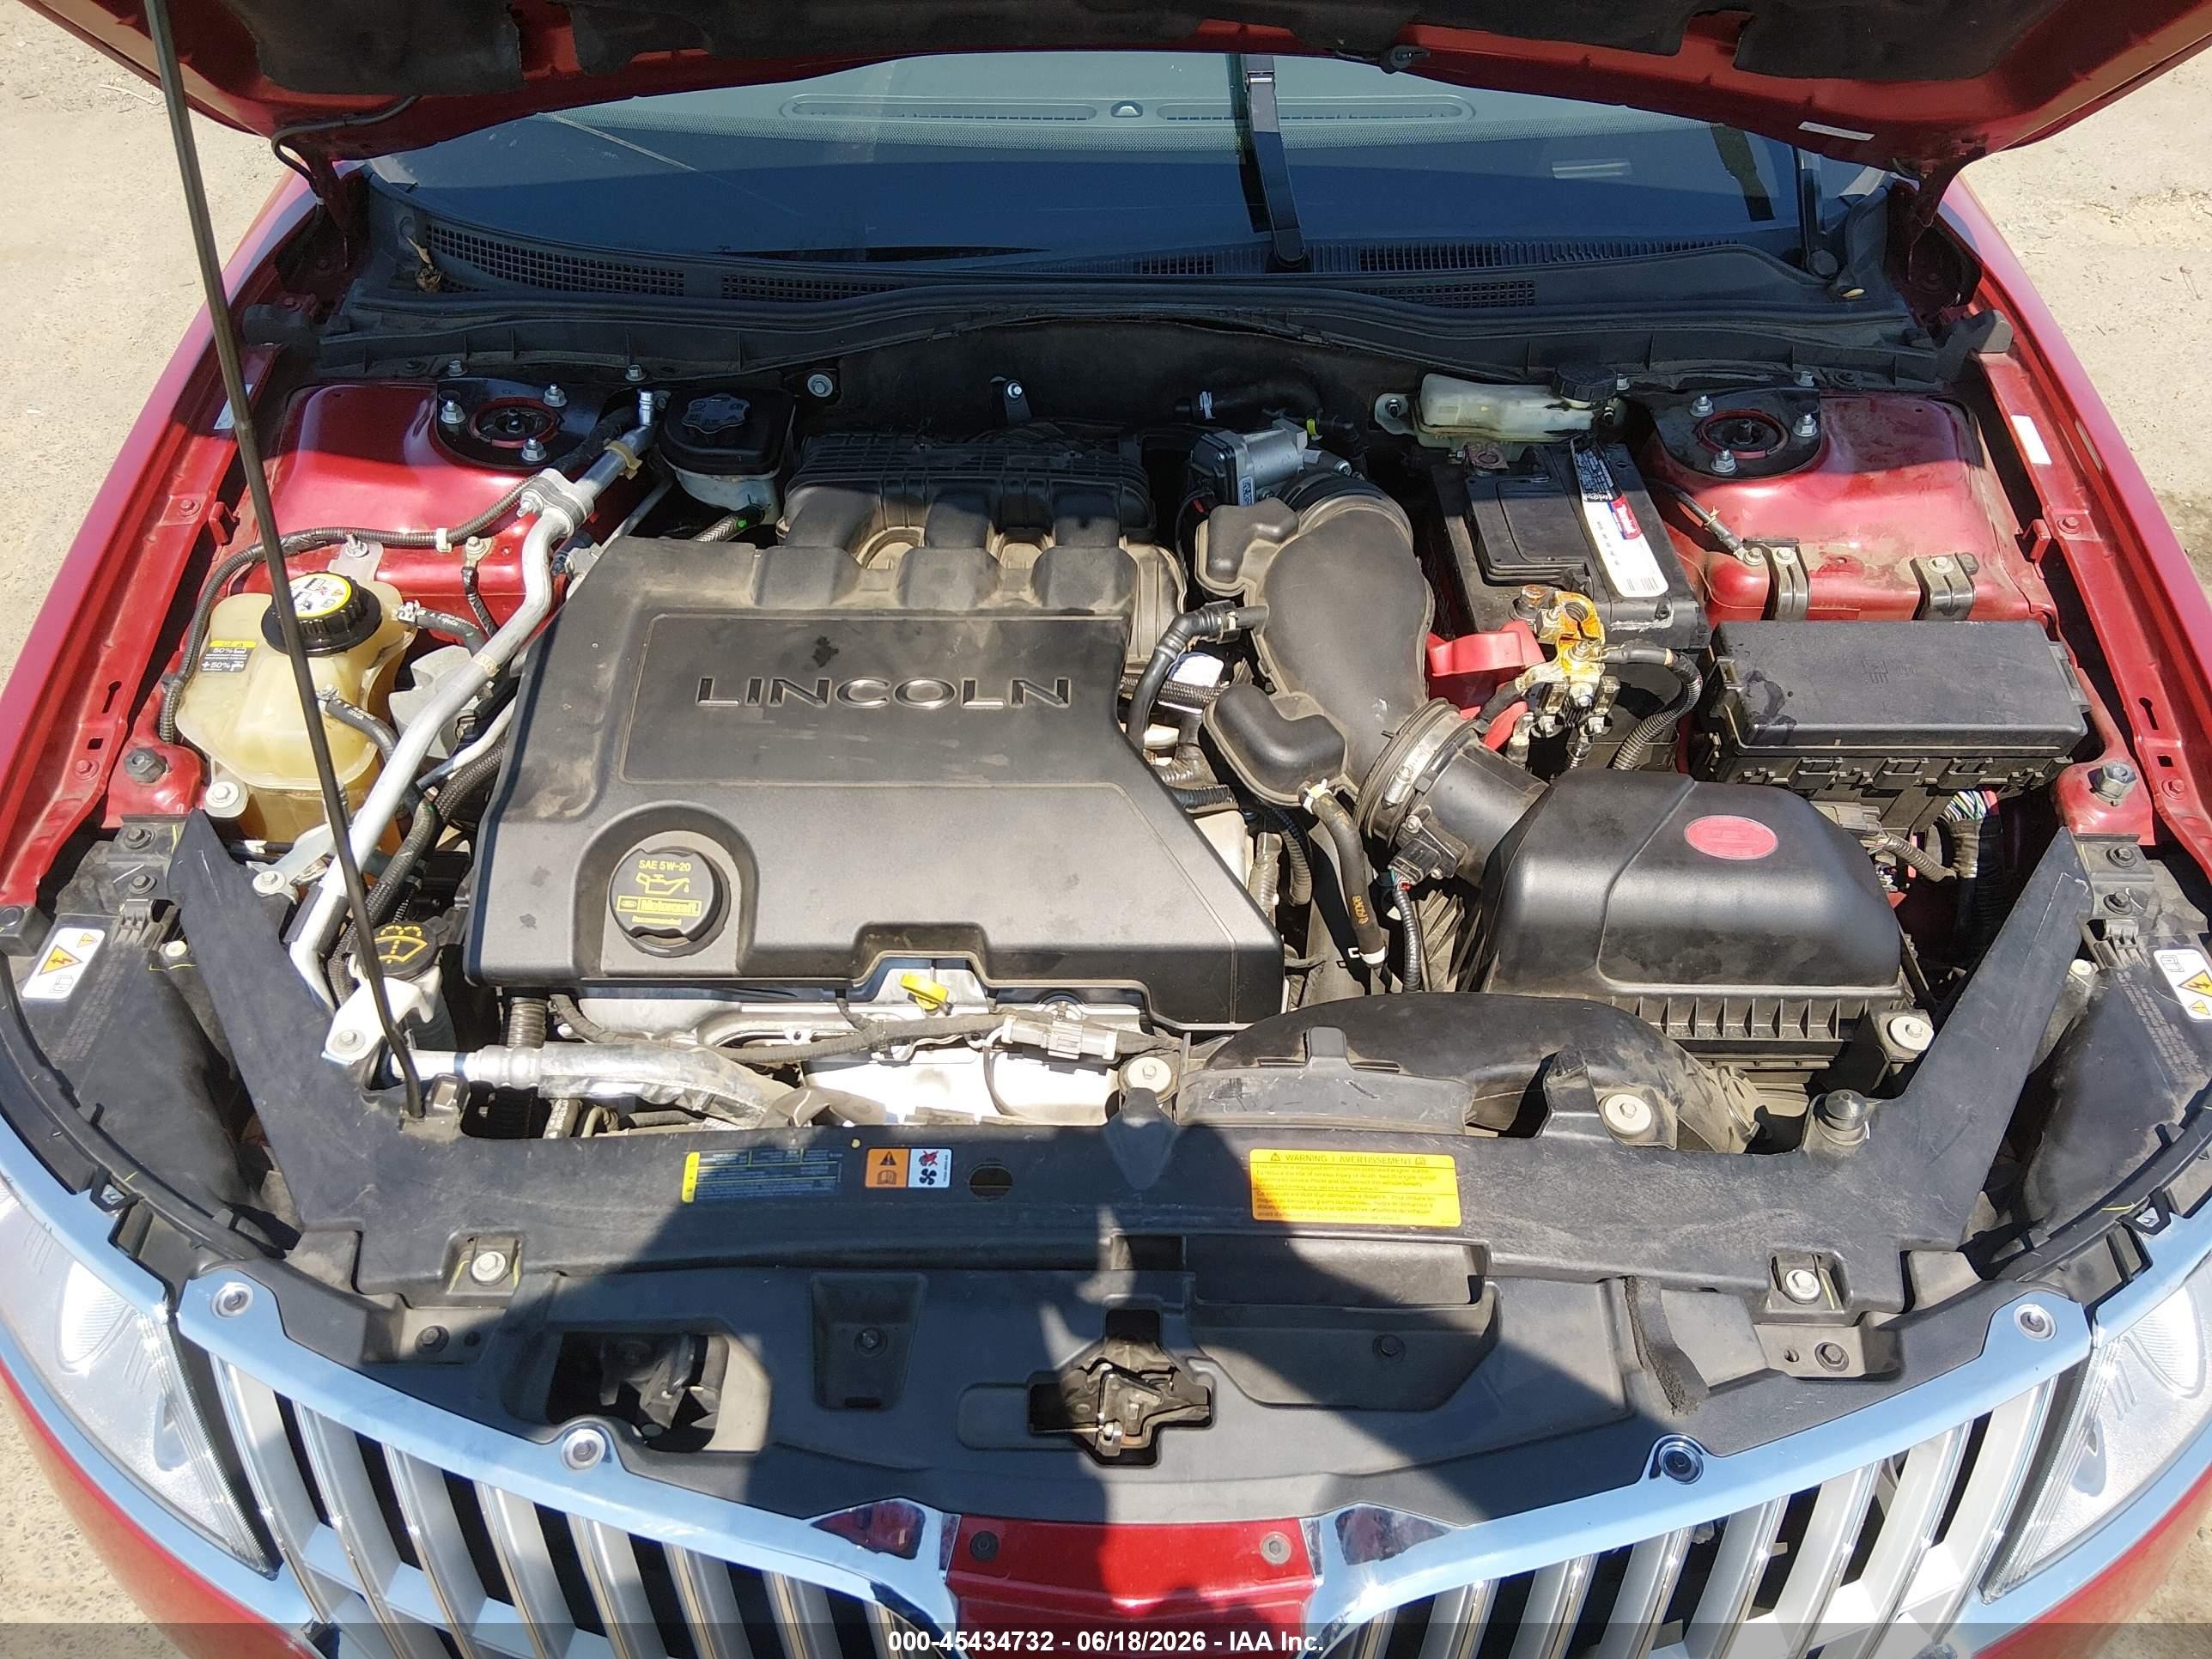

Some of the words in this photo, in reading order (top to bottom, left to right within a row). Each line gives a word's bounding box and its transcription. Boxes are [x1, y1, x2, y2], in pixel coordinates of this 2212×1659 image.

[696, 676, 1073, 709] LINCOLN
[638, 860, 659, 870] SAE
[659, 860, 691, 872] 5W-20
[641, 899, 697, 915] Motorcraft
